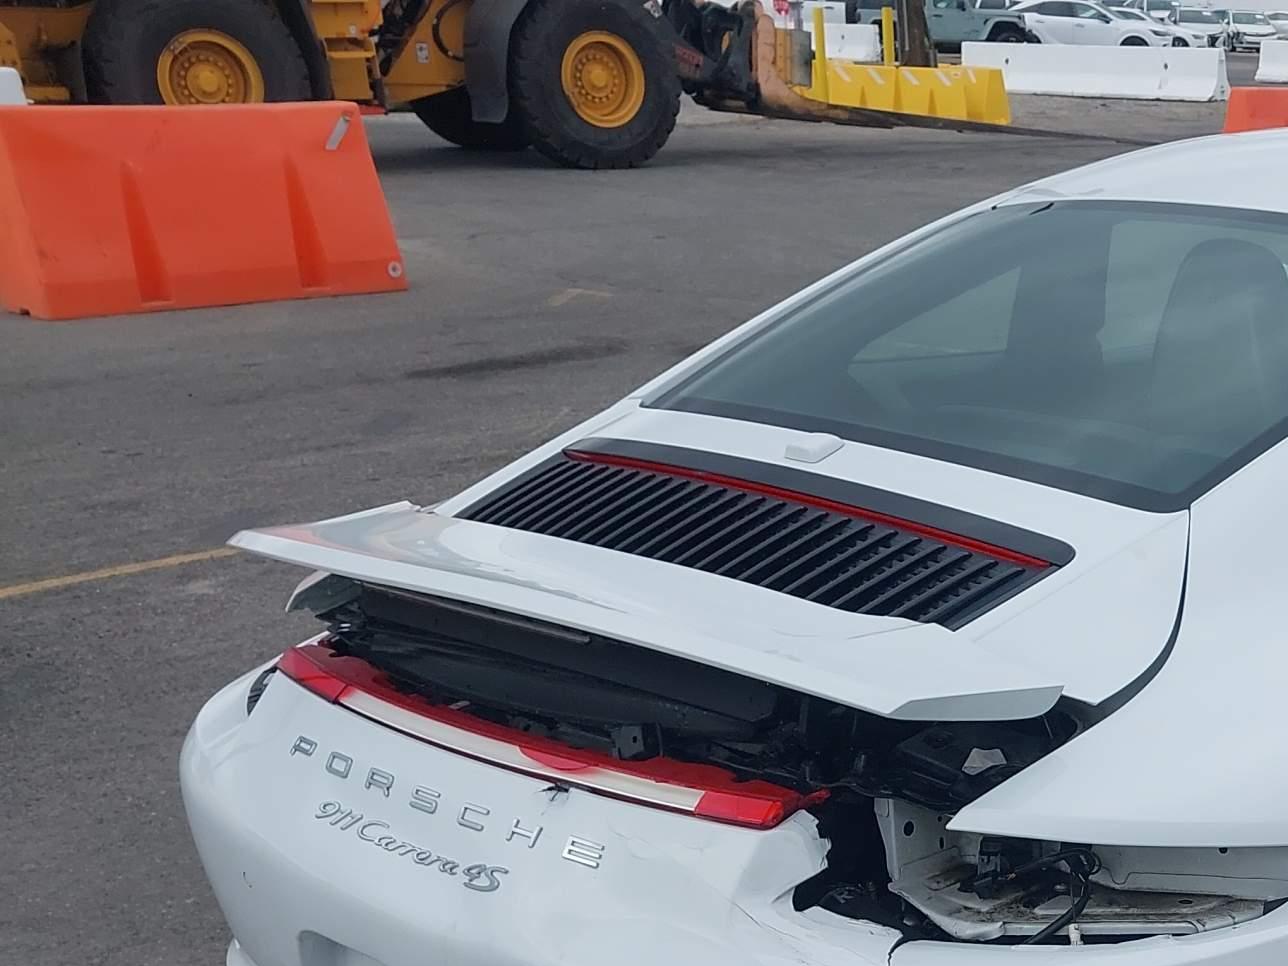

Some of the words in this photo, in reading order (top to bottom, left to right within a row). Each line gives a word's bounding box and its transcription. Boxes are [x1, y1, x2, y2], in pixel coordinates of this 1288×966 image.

[289, 735, 606, 869] PORSCHE
[315, 800, 364, 831] 911
[356, 819, 461, 876] Carrera
[462, 863, 510, 893] 4S
